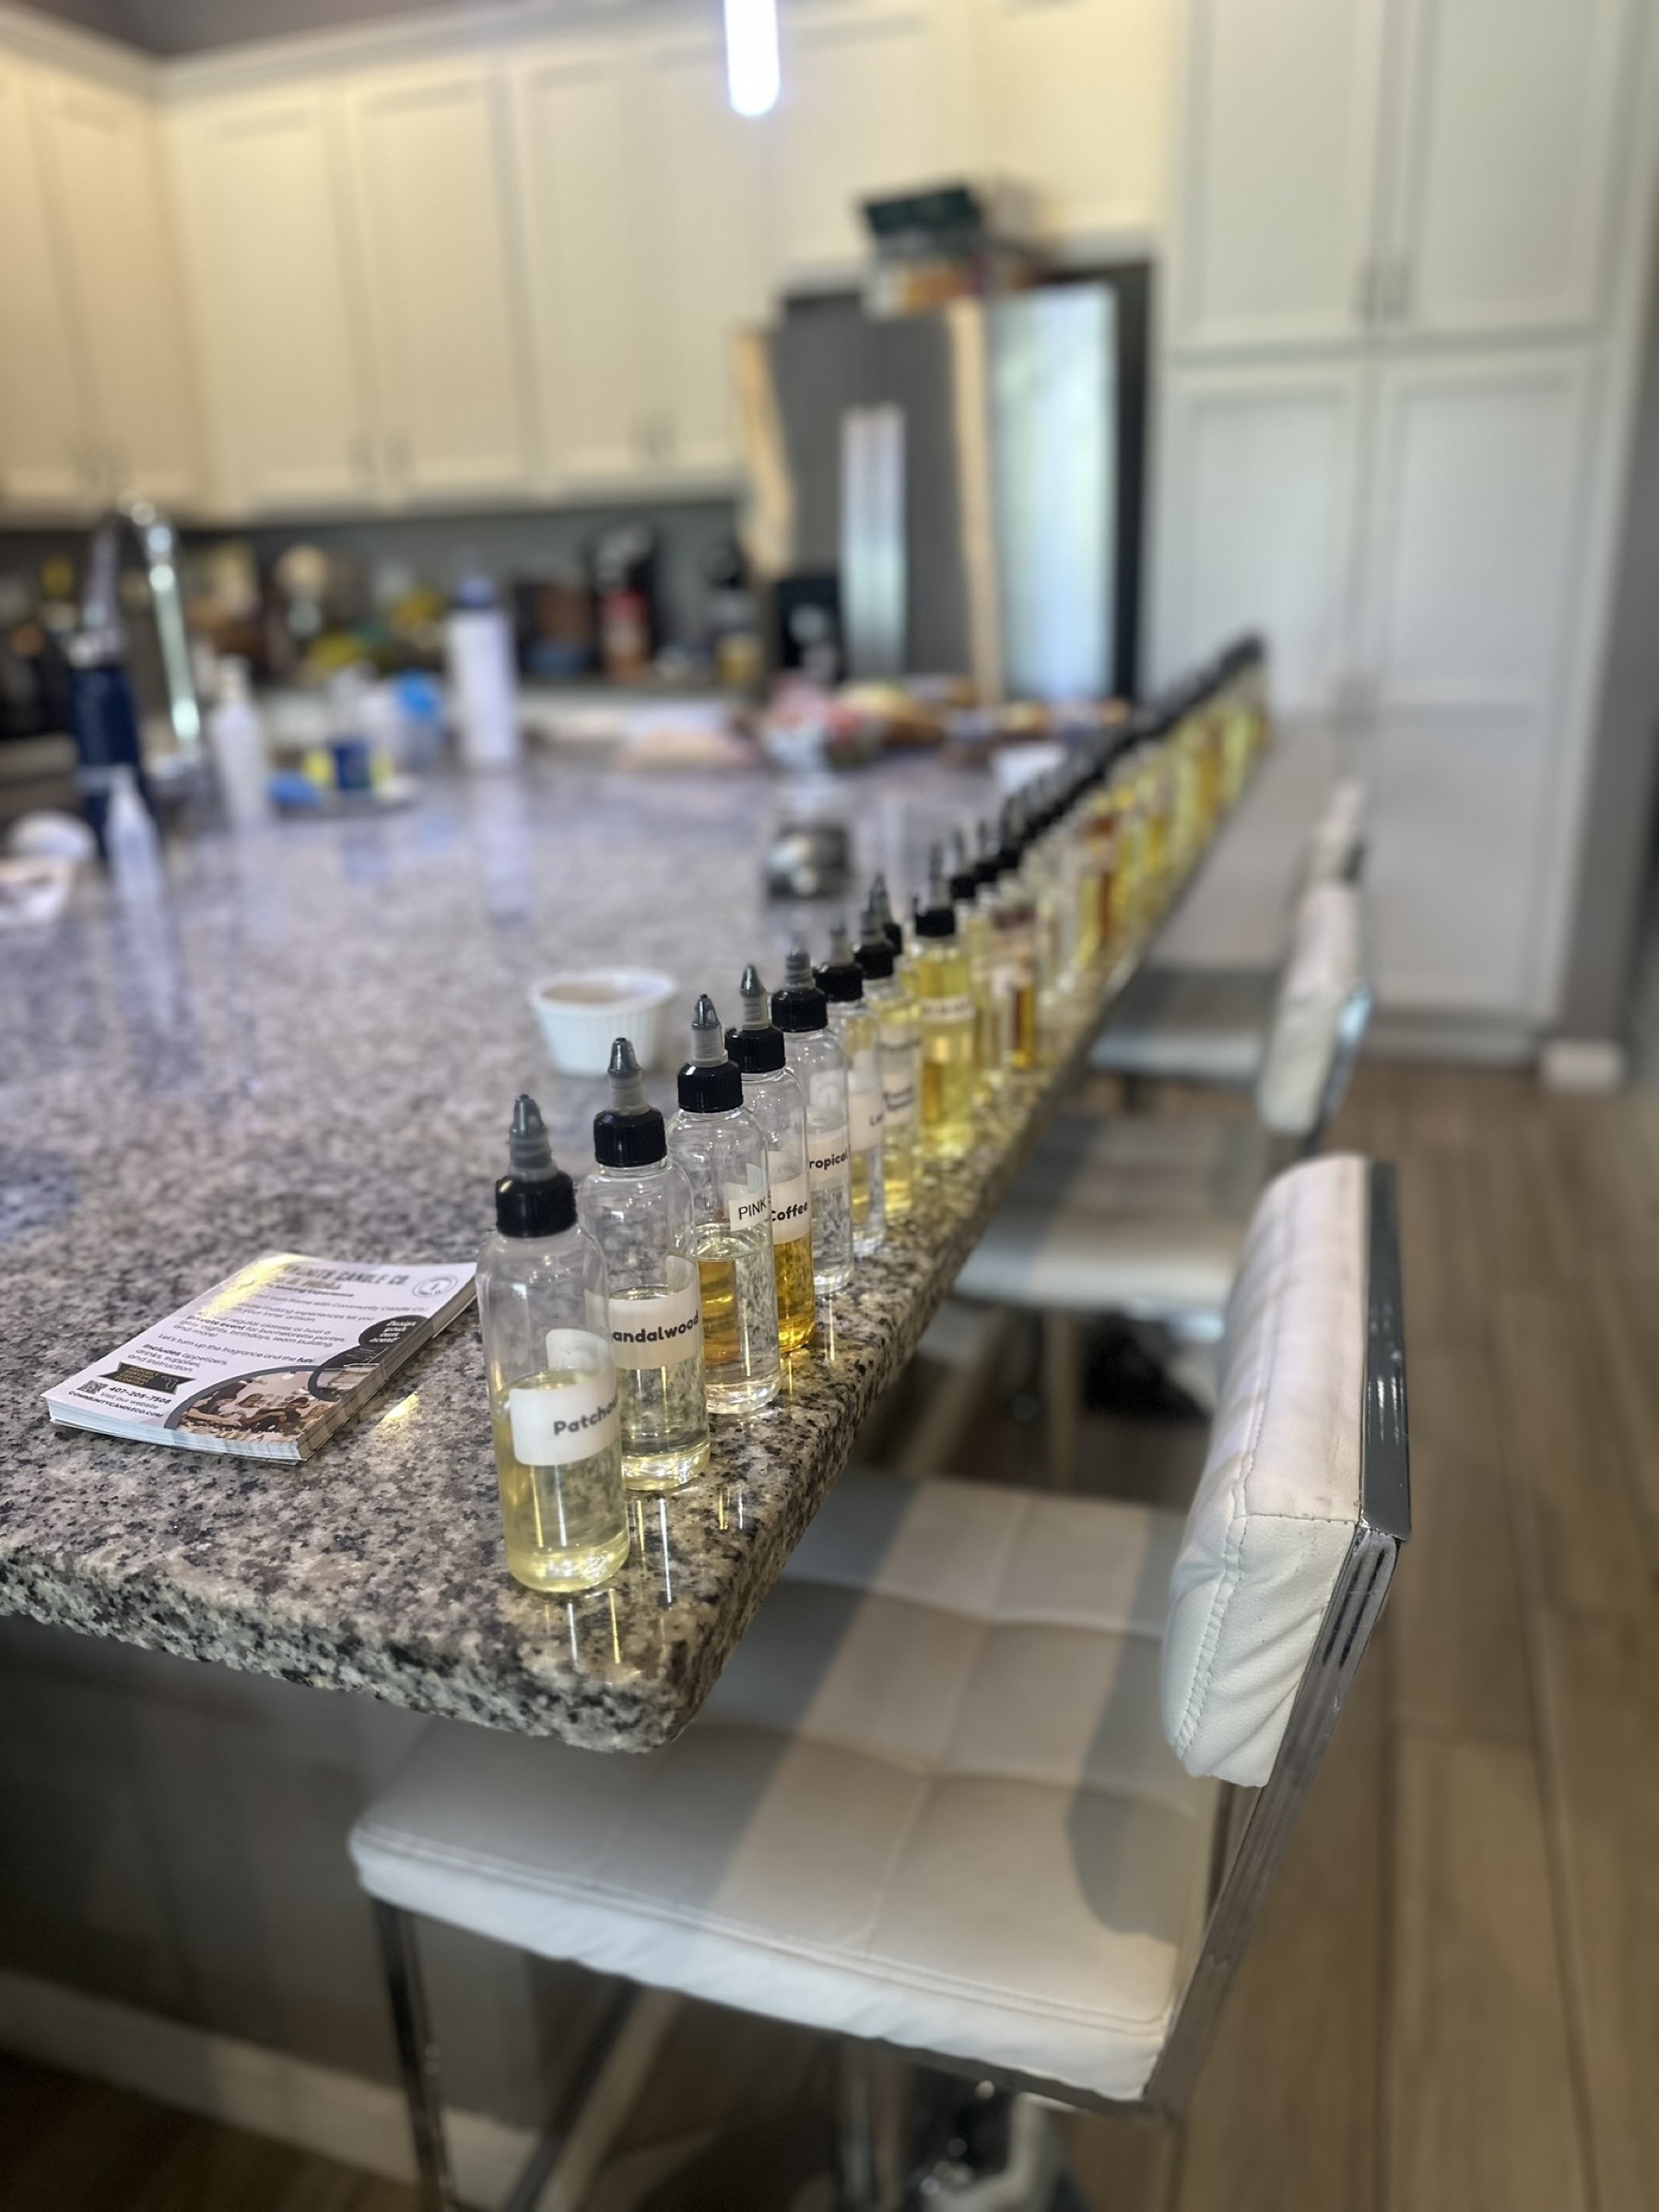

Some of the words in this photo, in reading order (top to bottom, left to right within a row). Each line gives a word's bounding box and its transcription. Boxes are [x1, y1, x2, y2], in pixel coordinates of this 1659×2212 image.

[808, 1147, 849, 1171] ropical
[737, 1196, 768, 1219] PINK
[262, 1305, 295, 1315] making
[294, 1310, 347, 1319] experiences
[331, 1302, 379, 1312] Community
[218, 1322, 247, 1331] event
[258, 1327, 314, 1339] bachelorette
[229, 1317, 260, 1326] regular
[260, 1322, 292, 1331] classes
[612, 1309, 700, 1344] andalwood
[142, 1343, 182, 1357] Includes
[206, 1344, 222, 1352] the
[220, 1347, 265, 1359] fragrance
[126, 1353, 147, 1362] and
[129, 1400, 160, 1410] website
